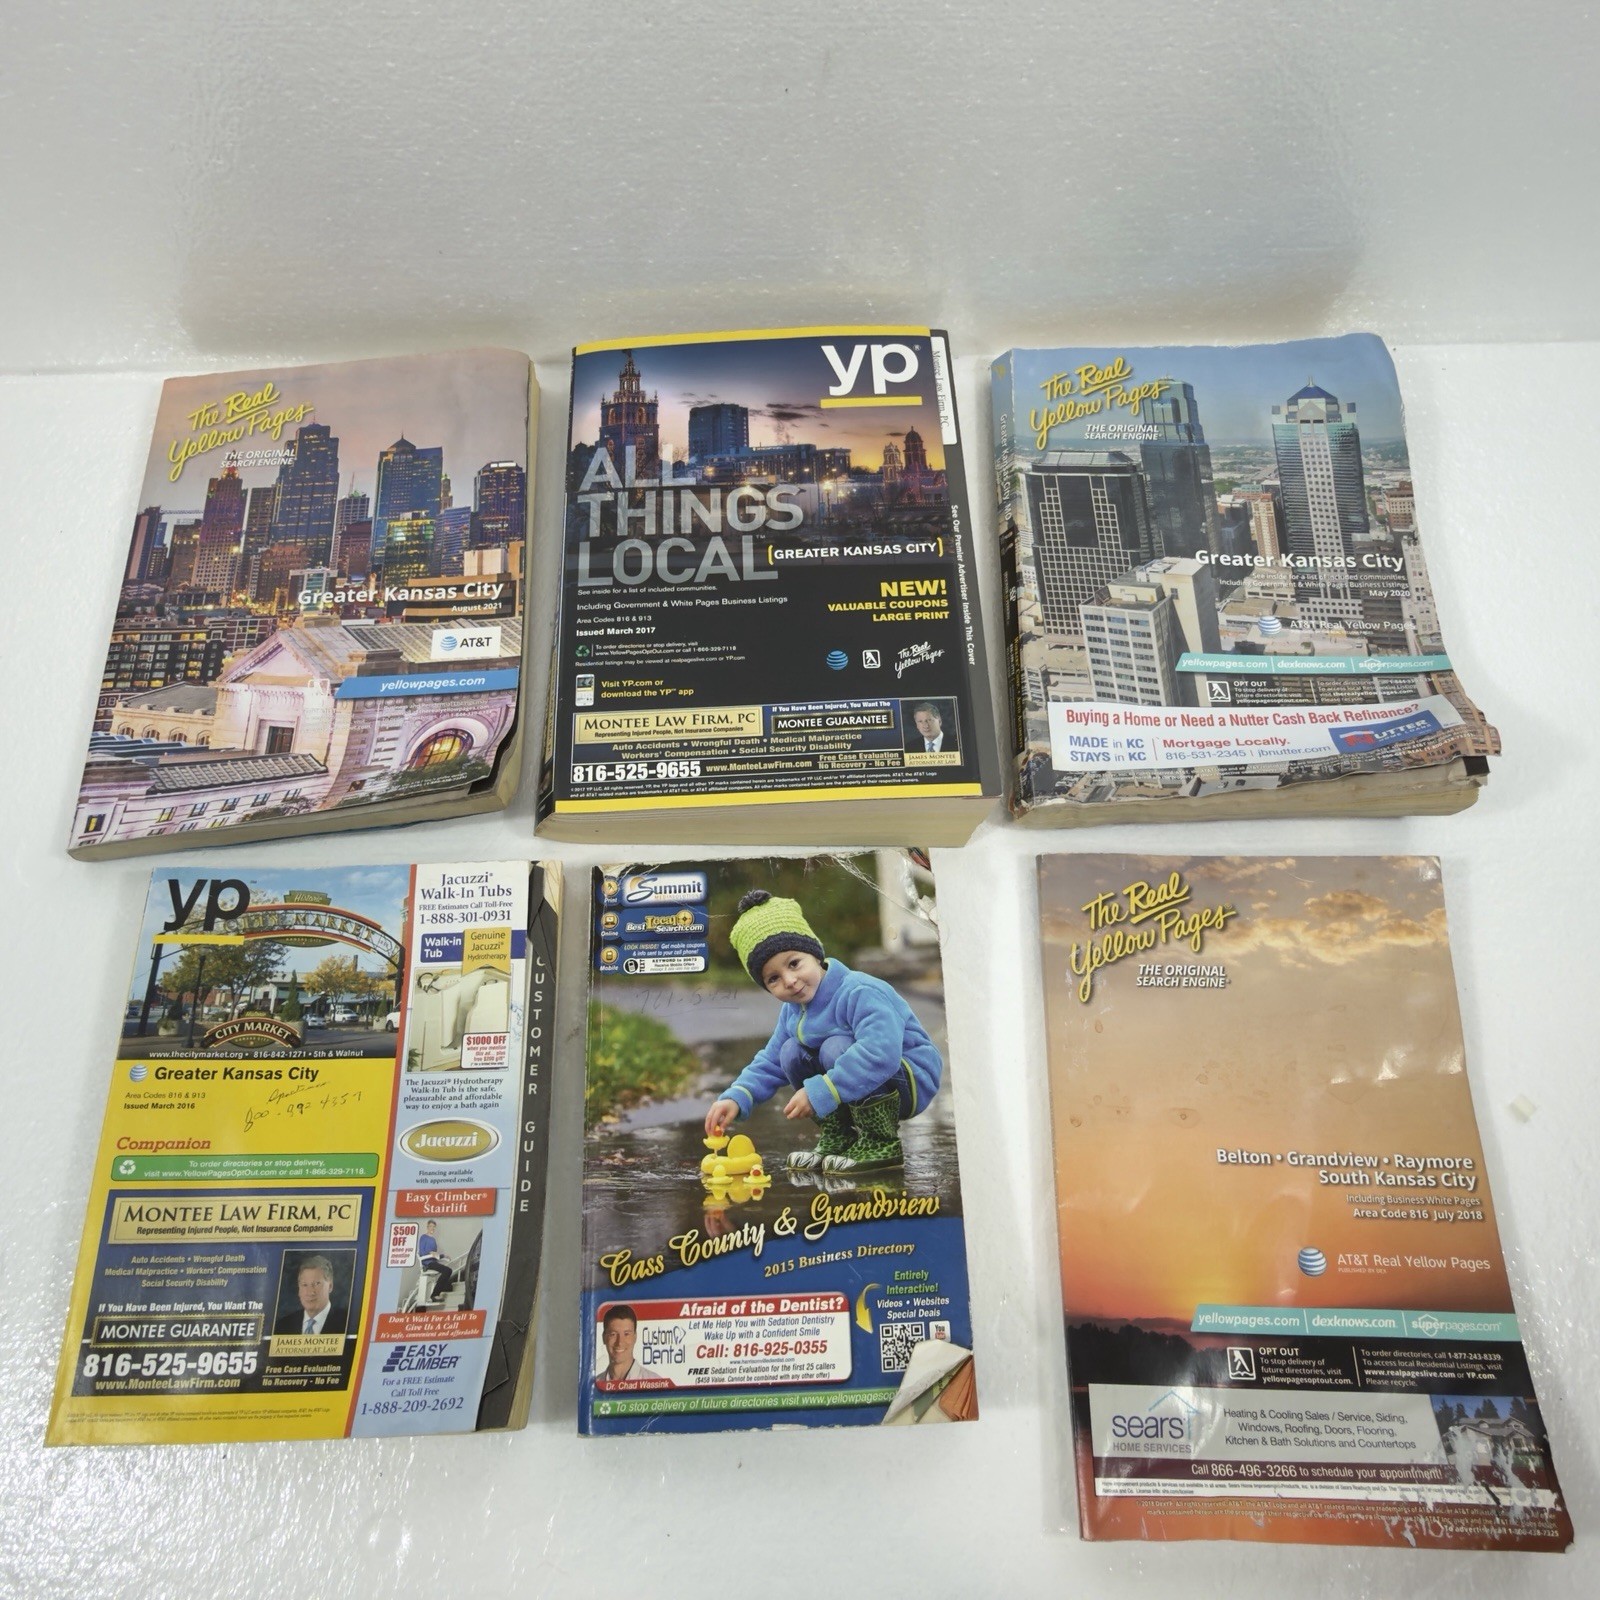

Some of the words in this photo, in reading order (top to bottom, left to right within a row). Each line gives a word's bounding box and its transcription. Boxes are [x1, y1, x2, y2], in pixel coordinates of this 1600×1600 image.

[821, 343, 919, 396] yp
[1040, 373, 1077, 400] The
[1076, 356, 1131, 388] Real
[187, 403, 224, 430] The
[224, 382, 280, 417] Real
[1030, 399, 1102, 450] Yellow
[1103, 382, 1170, 416] Pages
[1087, 424, 1105, 432] THE
[1109, 424, 1158, 432] ORIGINAL
[169, 426, 244, 482] Yellow
[246, 403, 314, 440] Pages
[221, 459, 256, 468] SEARCH
[258, 458, 293, 466] ENGINE
[225, 452, 242, 460] THE
[250, 449, 295, 459] ORIGINAL
[579, 443, 697, 492] ALL
[578, 485, 803, 538] THINGS
[844, 544, 902, 556] KANSAS
[954, 535, 963, 562] Premier
[577, 535, 778, 587] LOCAL
[1195, 550, 1274, 566] Greater
[1281, 553, 1357, 567] Kansas
[1363, 553, 1404, 571] City
[880, 579, 947, 597] NEW!
[958, 564, 968, 601] Advertiser
[298, 588, 378, 605] Greater
[385, 586, 457, 601] Kansas
[464, 582, 504, 600] City
[1369, 590, 1387, 598] May
[452, 604, 481, 613] August
[484, 602, 502, 610] 2021
[577, 602, 611, 611] Including
[614, 601, 660, 610] Government
[671, 599, 693, 607] White
[695, 598, 720, 607] Pages
[722, 597, 756, 605] Business
[759, 596, 788, 604] Listings
[828, 602, 886, 611] VALUABLE
[889, 600, 948, 609] COUPONS
[873, 613, 912, 621] LARGE
[915, 611, 949, 620] PRINT
[962, 602, 970, 624] Inside
[576, 628, 604, 636] Issued
[607, 627, 633, 635] March
[965, 626, 973, 641] This
[460, 637, 492, 648] AT&T
[967, 643, 975, 665] Cover
[1182, 658, 1267, 669] yellowpages.com
[1277, 660, 1345, 669] dexknows.com
[380, 677, 485, 692] yellowpages.com
[584, 717, 649, 730] MONTEE
[656, 714, 686, 726] LAW
[692, 713, 733, 725] FIRM,
[738, 713, 756, 723] PC
[777, 718, 823, 728] MONTEE
[826, 715, 888, 725] GUARANTEE
[1067, 710, 1108, 727] Buying
[1113, 715, 1120, 725] a
[1124, 712, 1160, 726] Home
[1165, 716, 1176, 727] or
[1181, 714, 1214, 727] Need
[1218, 716, 1226, 726] a
[1229, 714, 1269, 726] Nutter
[1273, 712, 1306, 726] Cash
[1310, 712, 1341, 724] Back
[1345, 703, 1419, 721] Refinance?
[1163, 739, 1230, 749] Mortgage
[1236, 737, 1290, 747] Locally.
[573, 761, 701, 782] 816-525-9655
[441, 872, 490, 887] Jacuzzi
[421, 887, 474, 900] Walk-In
[479, 886, 512, 897] Tubs
[627, 878, 702, 902] Summit
[163, 878, 250, 931] yp
[1081, 892, 1129, 929] The
[1123, 872, 1189, 914] Real
[420, 910, 511, 924] 1-888-301-0931
[1071, 929, 1155, 1002] Yellow
[1154, 906, 1237, 952] Pages
[1139, 964, 1162, 975] THE
[1165, 965, 1226, 976] ORIGINAL
[1136, 976, 1179, 986] SEARCH
[1182, 977, 1225, 987] ENGINE
[150, 1051, 243, 1059] www.thecitymarket.org
[336, 1049, 363, 1057] Walnut
[154, 1067, 217, 1080] Greater
[222, 1068, 282, 1080] Kansas
[286, 1067, 319, 1082] City
[116, 1137, 210, 1152] Companion
[520, 1121, 536, 1212] GUIDE
[1216, 1149, 1271, 1164] Belton
[1287, 1151, 1378, 1168] Grandview
[1394, 1154, 1473, 1172] Raymore
[1319, 1170, 1369, 1185] South
[1375, 1171, 1436, 1187] Kansas
[1441, 1172, 1476, 1191] City
[124, 1206, 212, 1222] MONTEE
[219, 1204, 260, 1221] LAW
[267, 1203, 321, 1221] FIRM,
[328, 1205, 351, 1219] PC
[1353, 1209, 1378, 1218] Area
[1381, 1209, 1408, 1218] Code
[1409, 1209, 1428, 1218] 816
[1433, 1209, 1454, 1221] July
[1457, 1210, 1483, 1220] 2018
[601, 1249, 665, 1286] Cass
[669, 1221, 766, 1267] County
[774, 1207, 797, 1236] &
[804, 1189, 940, 1240] Grandview
[764, 1260, 795, 1277] 2015
[798, 1249, 853, 1269] Business
[857, 1243, 914, 1257] Directory
[1337, 1254, 1368, 1266] AT&T
[1374, 1255, 1401, 1267] Real
[1405, 1256, 1447, 1269] Yellow
[1451, 1257, 1490, 1272] Pages
[894, 1270, 928, 1281] Entirely
[886, 1283, 938, 1295] Interactive!
[680, 1303, 726, 1317] Afraid
[731, 1302, 745, 1315] of
[750, 1301, 775, 1314] the
[780, 1297, 844, 1312] Dentist?
[1199, 1313, 1299, 1327] yellowpages.com
[1312, 1314, 1395, 1328] dexknows.com
[101, 1323, 164, 1339] MONTEE
[170, 1322, 255, 1337] GUARANTEE
[643, 1326, 674, 1346] Custom
[407, 1344, 447, 1357] EASY
[643, 1346, 686, 1365] Dental
[696, 1345, 728, 1358] Call:
[733, 1340, 827, 1357] 816-925-0355
[83, 1352, 258, 1377] 816-525-9655
[399, 1357, 459, 1371] CLIMBER
[95, 1378, 240, 1390] www.MonteeLawFirm.com
[361, 1398, 464, 1415] 1-888-209-2692
[1113, 1415, 1184, 1439] sears
[1113, 1442, 1140, 1452] HOME
[1144, 1443, 1191, 1453] SERVICES
